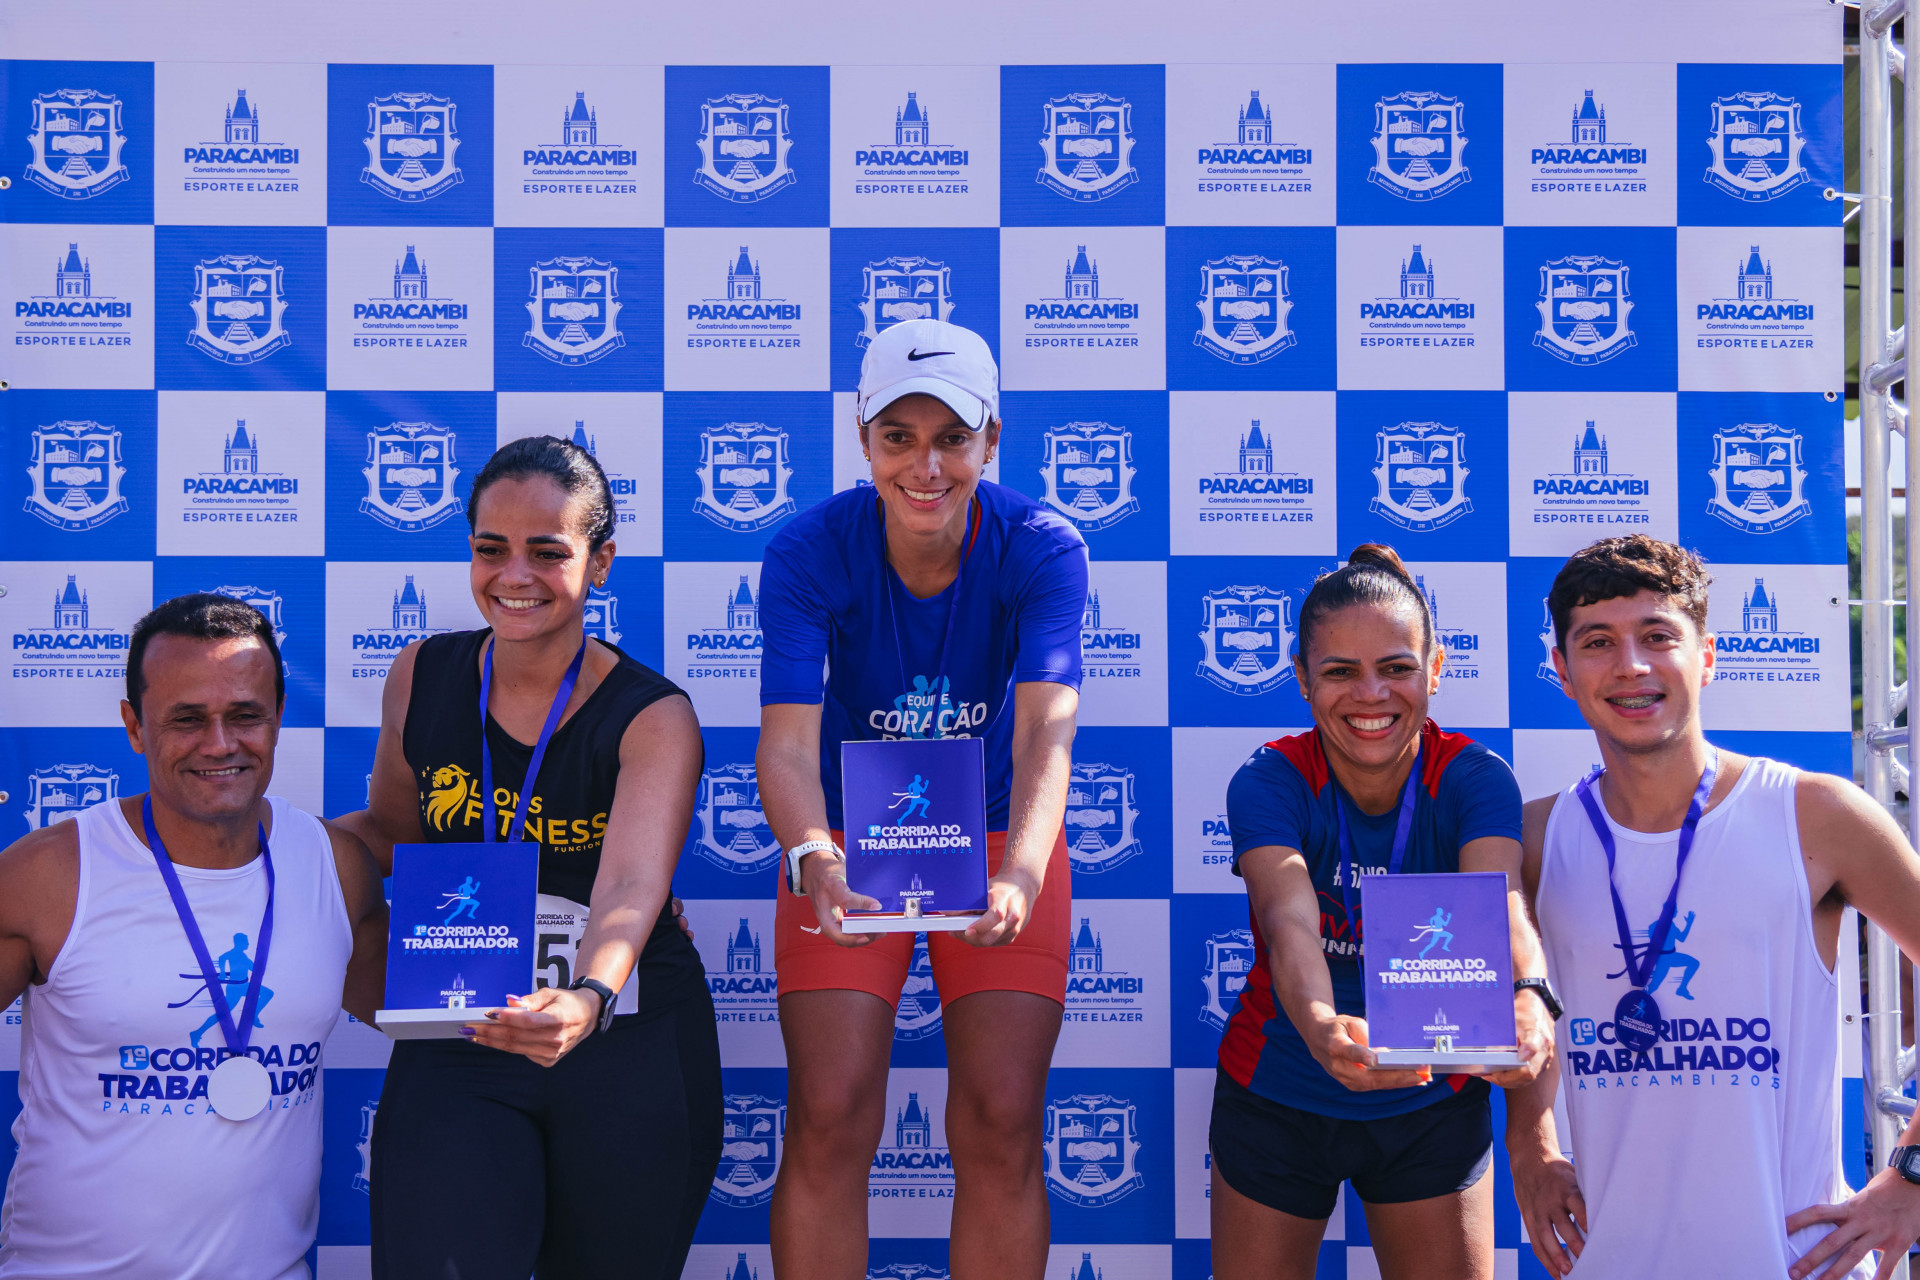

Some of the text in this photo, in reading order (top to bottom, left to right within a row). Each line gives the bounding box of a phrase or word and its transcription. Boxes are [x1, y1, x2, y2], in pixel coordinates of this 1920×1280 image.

[184, 148, 299, 164] PARACAMBI
[856, 150, 968, 166] PARACAMBI
[1532, 148, 1646, 164] PARACAMBI
[184, 182, 299, 192] ESPORTE E LAZER
[856, 184, 968, 194] ESPORTE E LAZER
[1532, 183, 1591, 192] ESPORTE
[1605, 183, 1646, 192] LAZER
[16, 302, 131, 318] PARACAMBI
[688, 304, 800, 320] PARACAMBI
[1026, 303, 1138, 320] PARACAMBI
[1698, 304, 1813, 320] PARACAMBI
[1107, 322, 1130, 330] tempo
[16, 336, 131, 346] ESPORTE E LAZER
[688, 339, 800, 348] ESPORTE E LAZER
[1026, 338, 1138, 347] ESPORTE E LAZER
[1698, 339, 1813, 348] ESPORTE E LAZER
[184, 478, 298, 494] PARACAMBI
[1200, 478, 1313, 494] PARACAMBI
[1534, 479, 1649, 495] PARACAMBI
[184, 513, 242, 522] ESPORTE
[256, 514, 298, 522] LAZER
[1200, 513, 1313, 522] ESPORTE E LAZER
[1534, 514, 1594, 523] ESPORTE
[1608, 515, 1649, 523] LAZER
[13, 634, 129, 649] PARACAMBI
[13, 669, 128, 678] ESPORTE E LAZER
[907, 694, 949, 708] EQUIE
[869, 702, 987, 736] CORAÇÃO
[470, 778, 543, 814] LONS
[464, 799, 608, 845] FTNESS
[882, 825, 936, 837] CORRIDA
[940, 824, 960, 836] DO
[554, 840, 600, 852] FUNCION
[858, 836, 972, 850] TRABALHADOR
[427, 926, 486, 937] CORRIDA
[488, 926, 509, 936] DO
[402, 938, 518, 949] TRABALHADOR
[536, 934, 582, 990] 5
[1402, 959, 1463, 970] CORRIDA
[1464, 958, 1486, 969] DO
[1379, 970, 1497, 984] TRABALHADOR
[1066, 978, 1142, 994] ACAMBI
[1091, 1014, 1098, 1022] E
[1102, 1014, 1143, 1022] LAZER
[1574, 1018, 1770, 1045] 1ª CRIDA DO
[150, 1045, 284, 1071] CORRDA
[288, 1042, 321, 1067] DO
[1568, 1046, 1780, 1076] RABALHADOR
[98, 1065, 318, 1100] TRABADOR
[1578, 1074, 1780, 1090] ARACAMBI 205
[103, 1091, 314, 1116] PARACAI 2025
